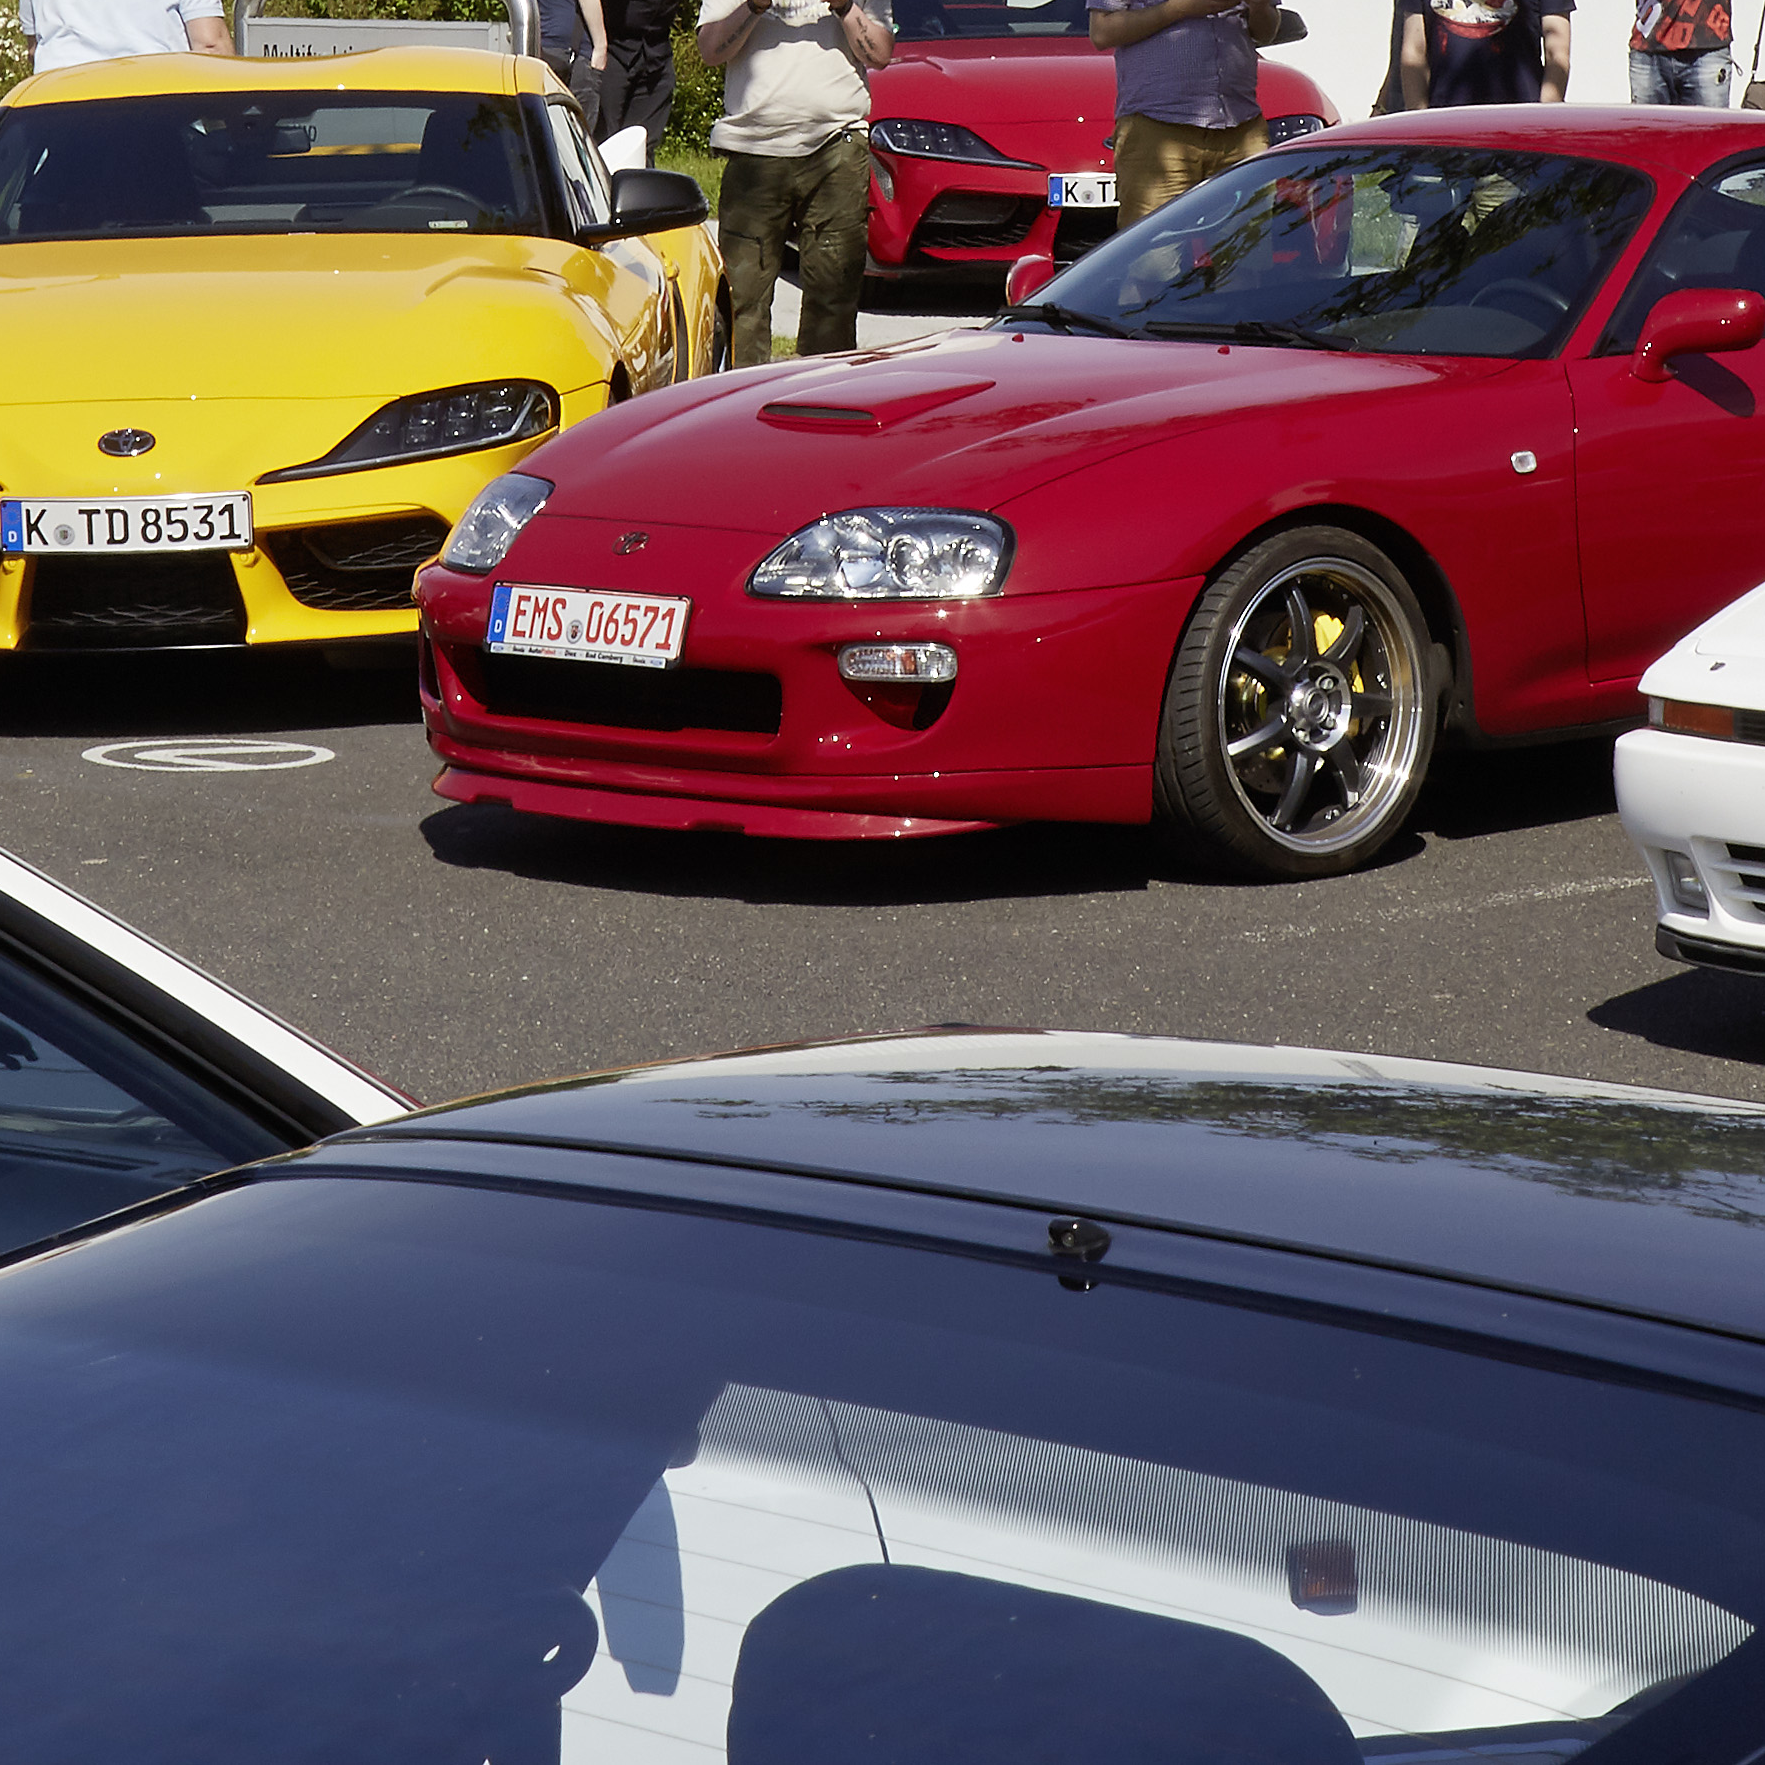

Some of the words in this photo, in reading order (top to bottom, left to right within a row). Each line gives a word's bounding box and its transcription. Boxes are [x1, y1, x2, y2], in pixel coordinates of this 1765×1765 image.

[1065, 181, 1079, 203] K
[25, 508, 49, 546] K
[78, 508, 130, 545] TD
[141, 503, 242, 544] 8531
[8, 530, 17, 542] D
[493, 619, 503, 634] D
[512, 595, 567, 641] EMS
[585, 601, 676, 651] 06571
